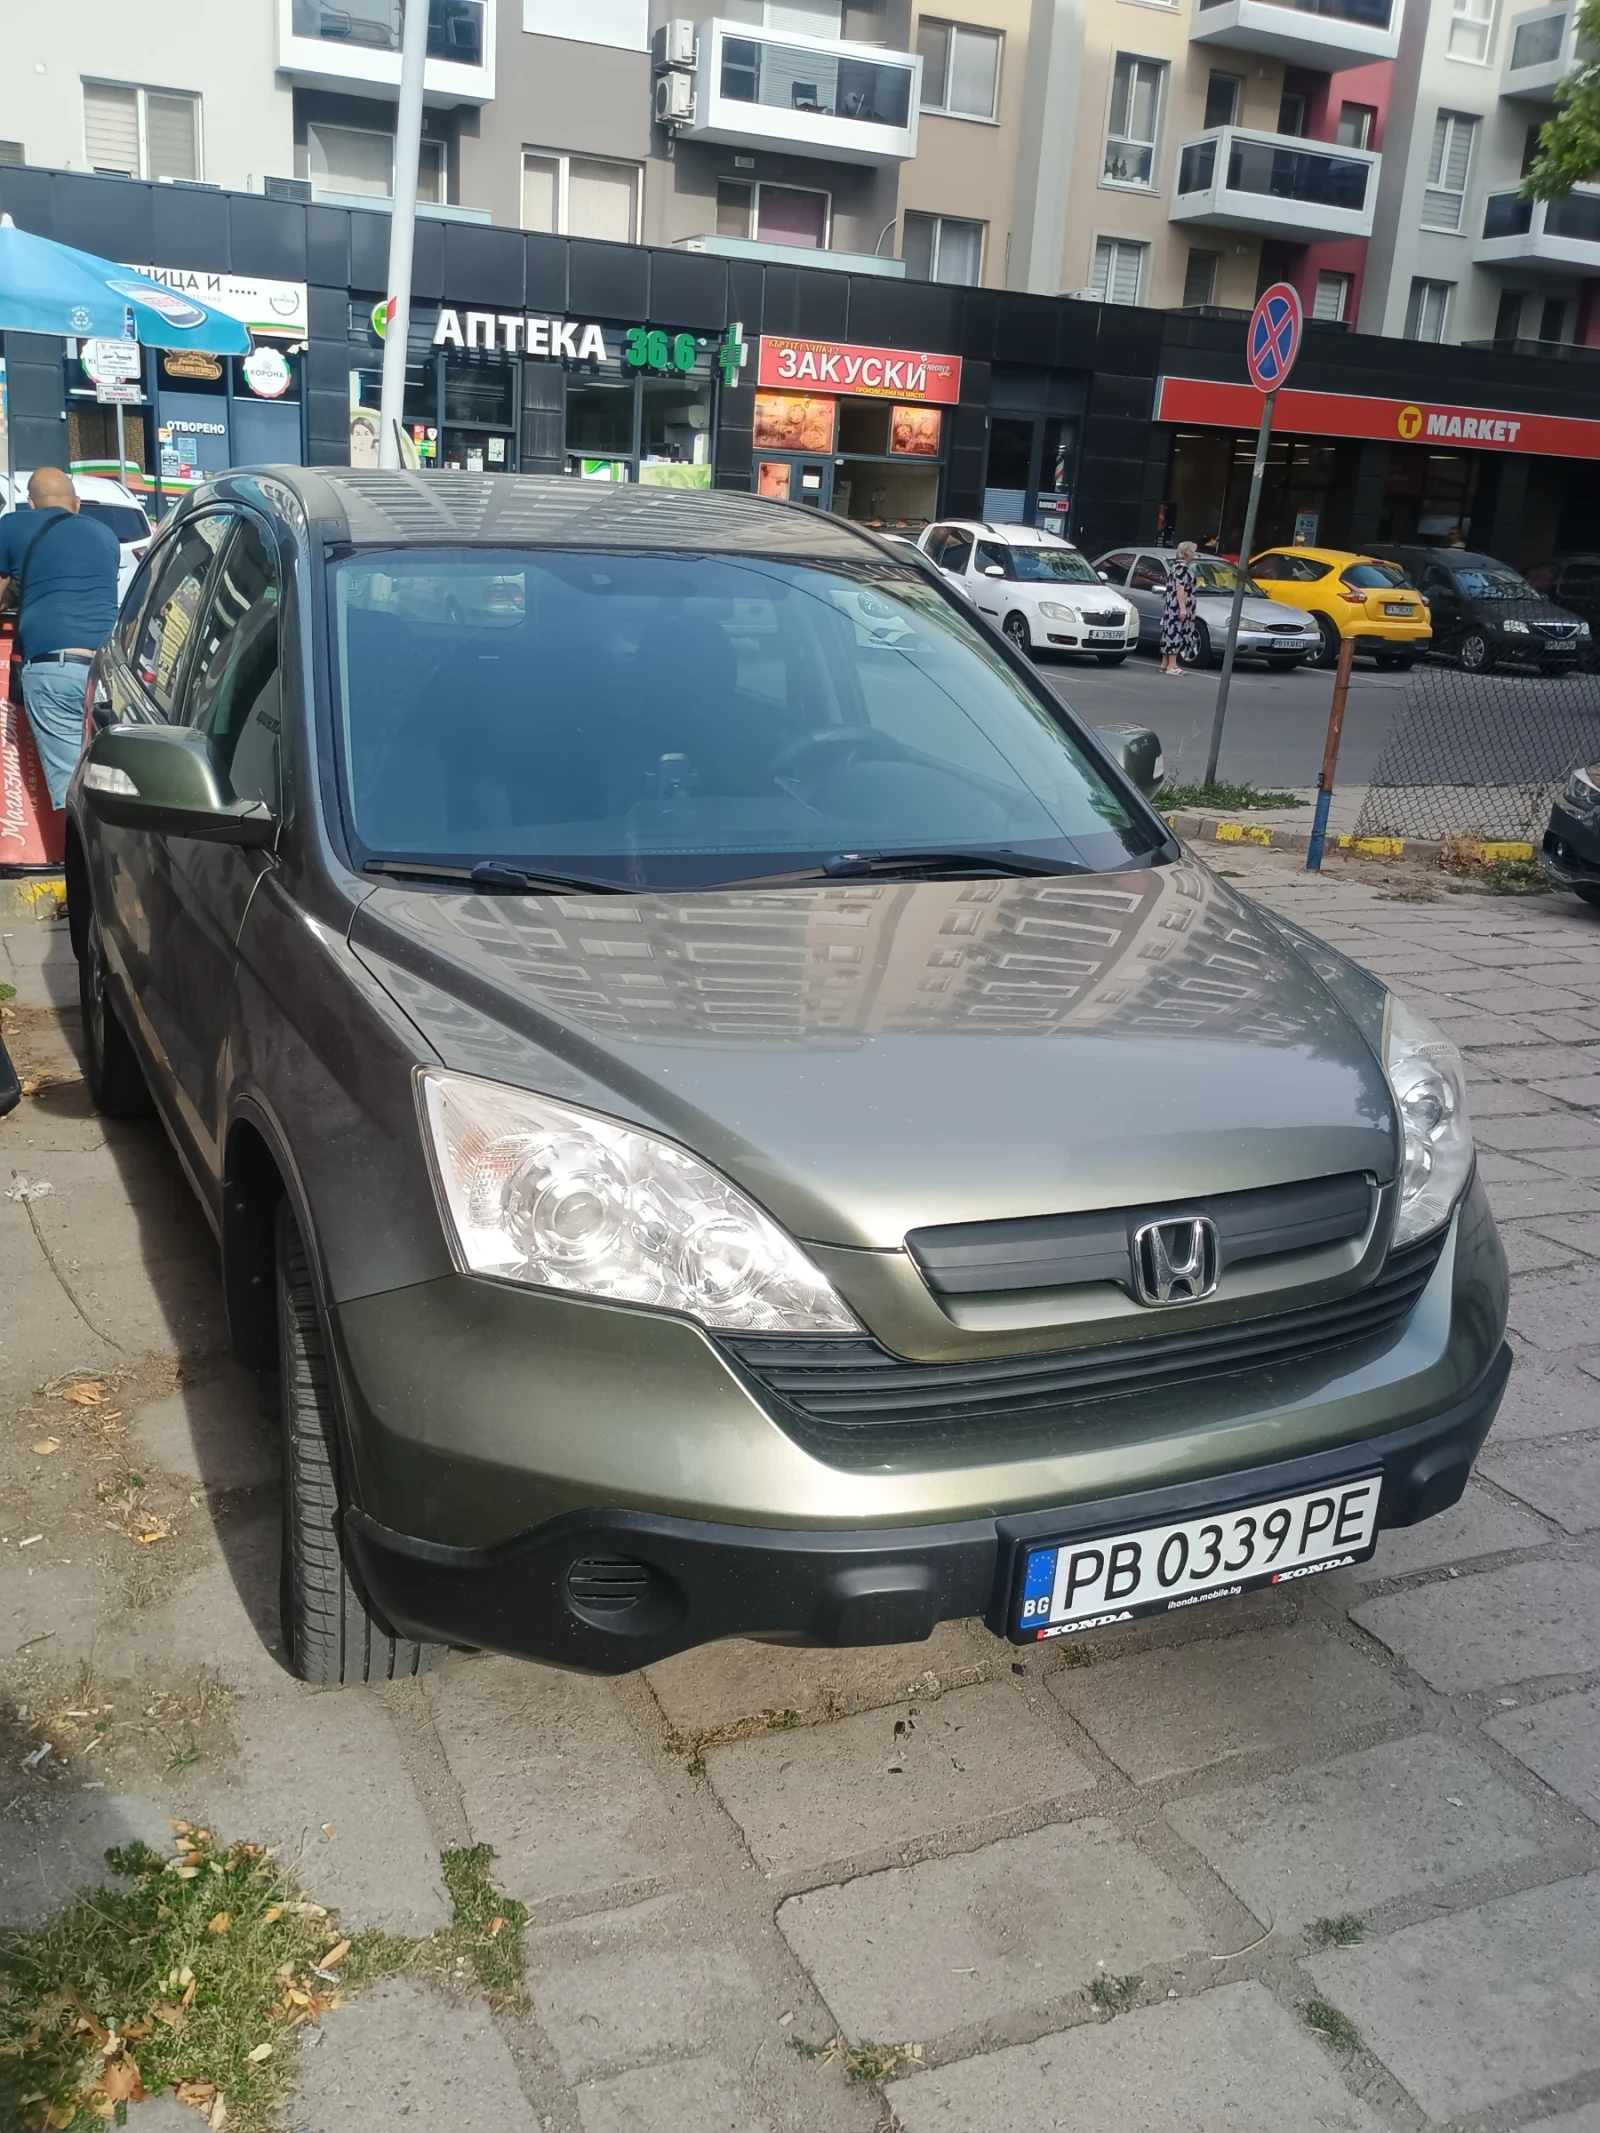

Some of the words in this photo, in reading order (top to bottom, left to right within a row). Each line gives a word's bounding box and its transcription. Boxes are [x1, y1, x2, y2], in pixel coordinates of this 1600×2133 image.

[207, 275, 221, 292] И
[433, 309, 607, 361] АПТЕКА
[250, 369, 284, 379] КОРОНА
[778, 348, 927, 391] ЗАКУСКИ
[166, 420, 226, 435] ОТВОРЕНО
[1426, 413, 1521, 443] MARKET
[1023, 1596, 1049, 1618] BG
